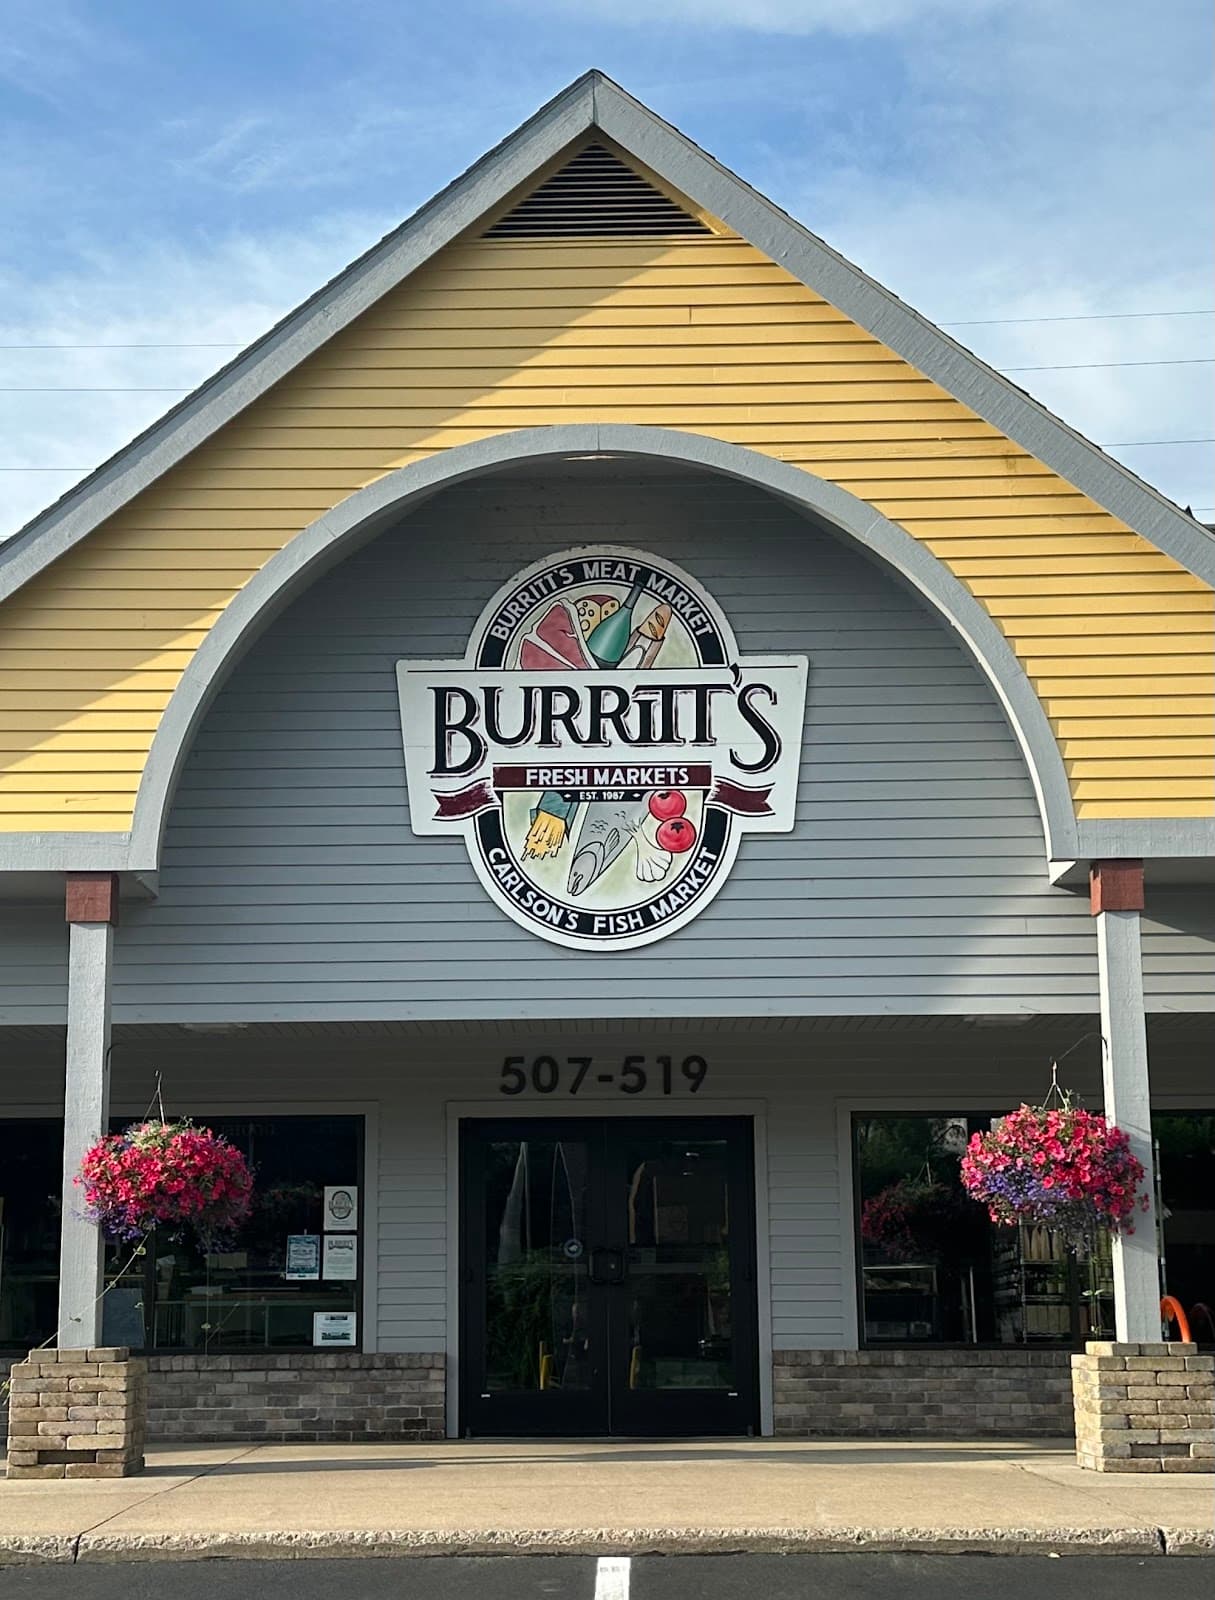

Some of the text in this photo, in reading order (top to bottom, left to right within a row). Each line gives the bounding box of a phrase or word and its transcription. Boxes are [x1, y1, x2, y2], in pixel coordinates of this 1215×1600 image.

[490, 561, 713, 641] BURRITT'S MEAT MARKET
[426, 662, 782, 778] BURRITT'S
[526, 768, 689, 785] FRESH MARKETS
[579, 791, 599, 800] EST.
[488, 847, 718, 934] CARLSON'S FISH MARKET
[500, 1055, 708, 1095] 507-519
